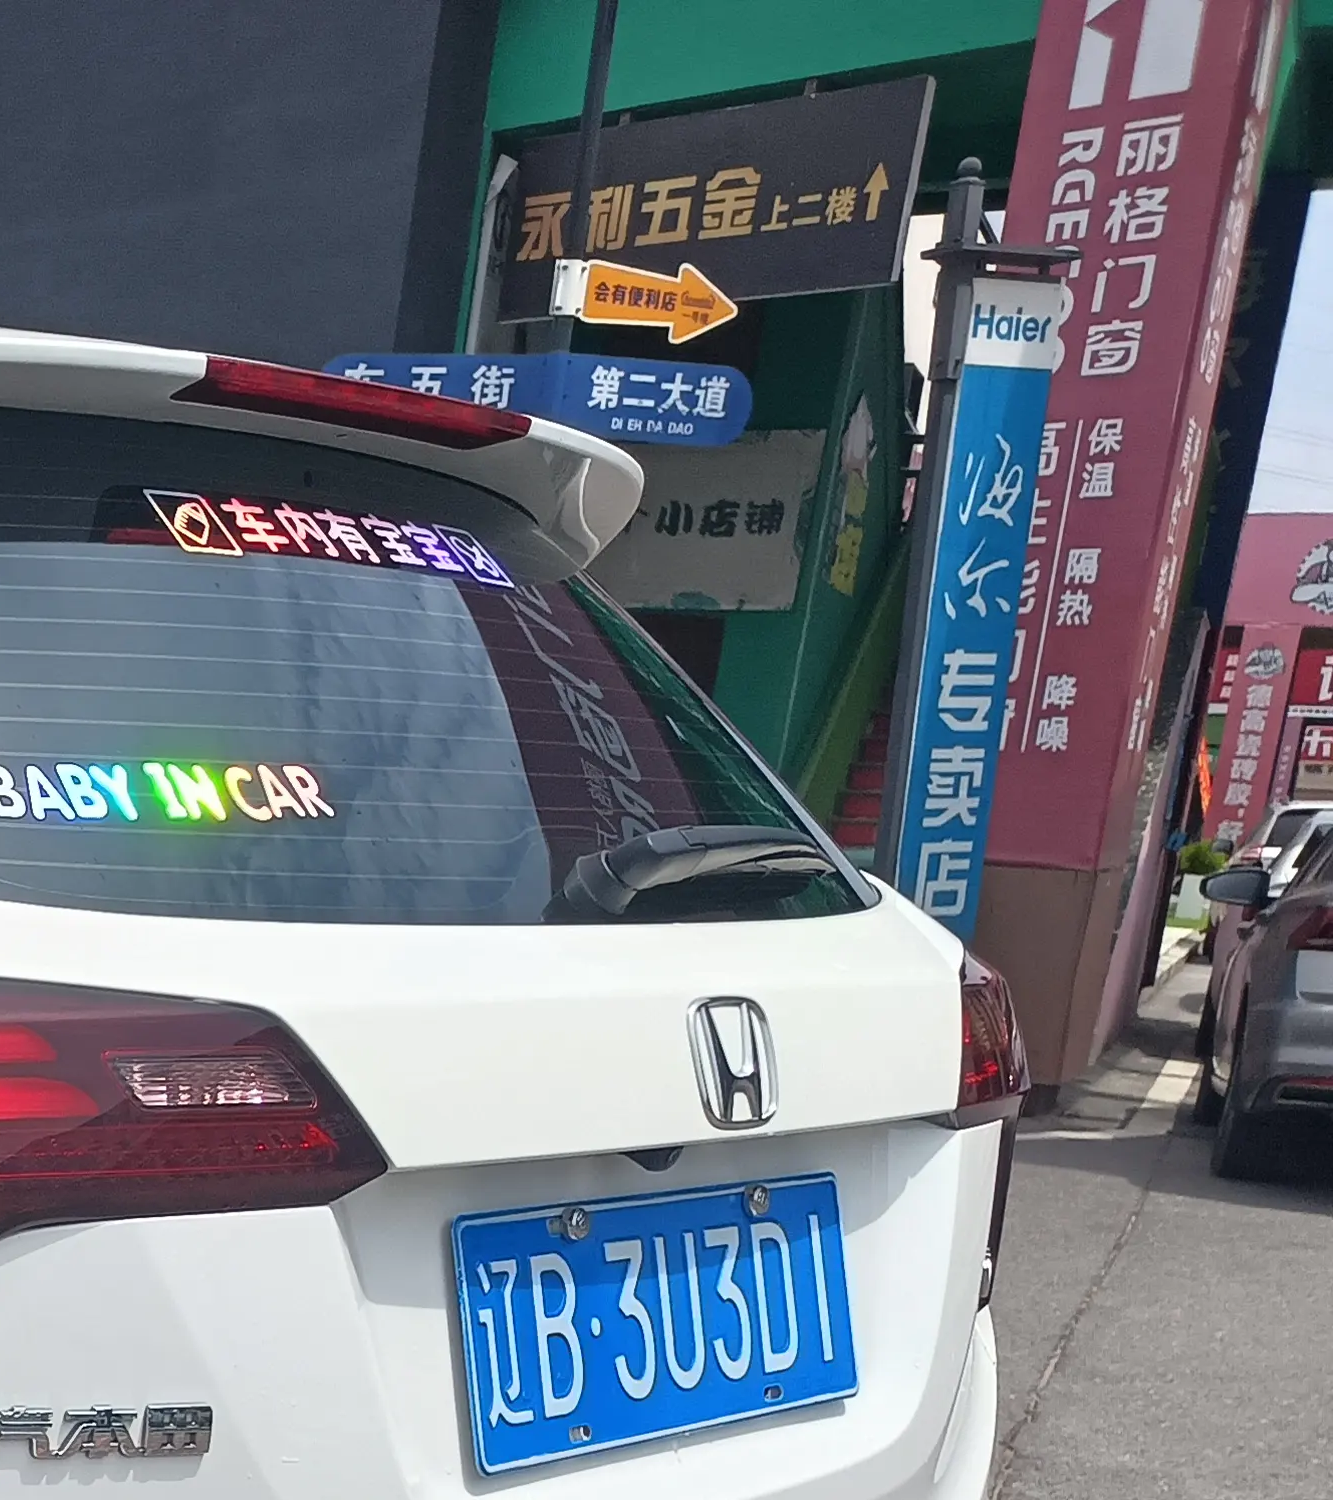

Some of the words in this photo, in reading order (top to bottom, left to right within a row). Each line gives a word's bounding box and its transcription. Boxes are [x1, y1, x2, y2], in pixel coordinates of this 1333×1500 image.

[516, 166, 761, 261] 永利五金
[761, 186, 858, 232] 上二楼
[1081, 114, 1184, 376] 丽格门窗
[594, 281, 678, 312] 会有便利店
[971, 304, 1052, 344] Haier
[587, 365, 730, 419] 第二大道
[668, 422, 694, 435] DAO
[1079, 418, 1124, 498] 保温
[220, 498, 465, 573] 车内有宝宝
[624, 498, 785, 537] 小店铺
[1056, 548, 1102, 626] 隔热
[1035, 674, 1078, 752] 降噪
[143, 761, 226, 821] IN
[223, 764, 335, 821] CAR
